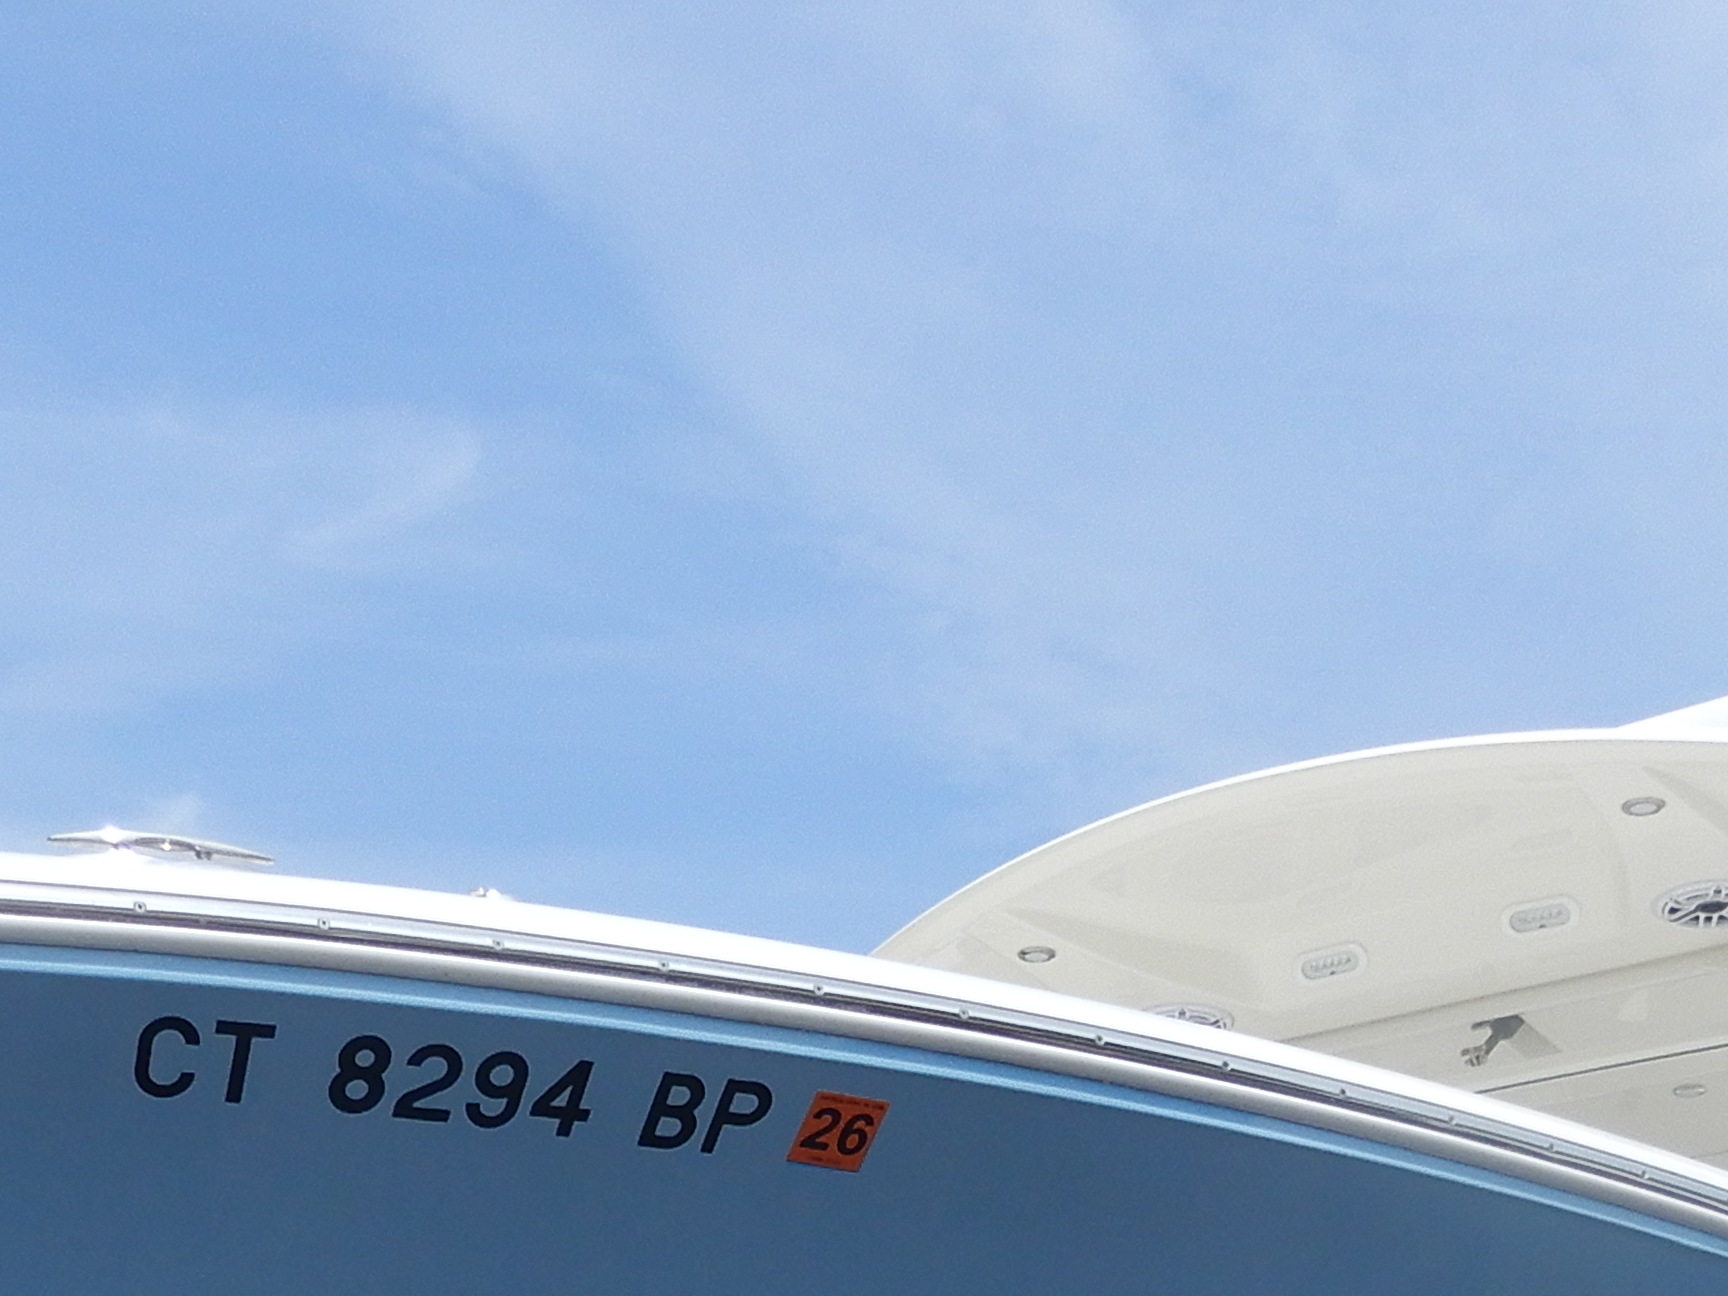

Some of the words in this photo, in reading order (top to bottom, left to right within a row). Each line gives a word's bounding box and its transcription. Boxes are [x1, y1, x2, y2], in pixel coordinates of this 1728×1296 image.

[134, 1016, 276, 1104] CT
[327, 1034, 595, 1138] 8294
[637, 1071, 774, 1155] BP
[799, 1107, 874, 1156] 26
